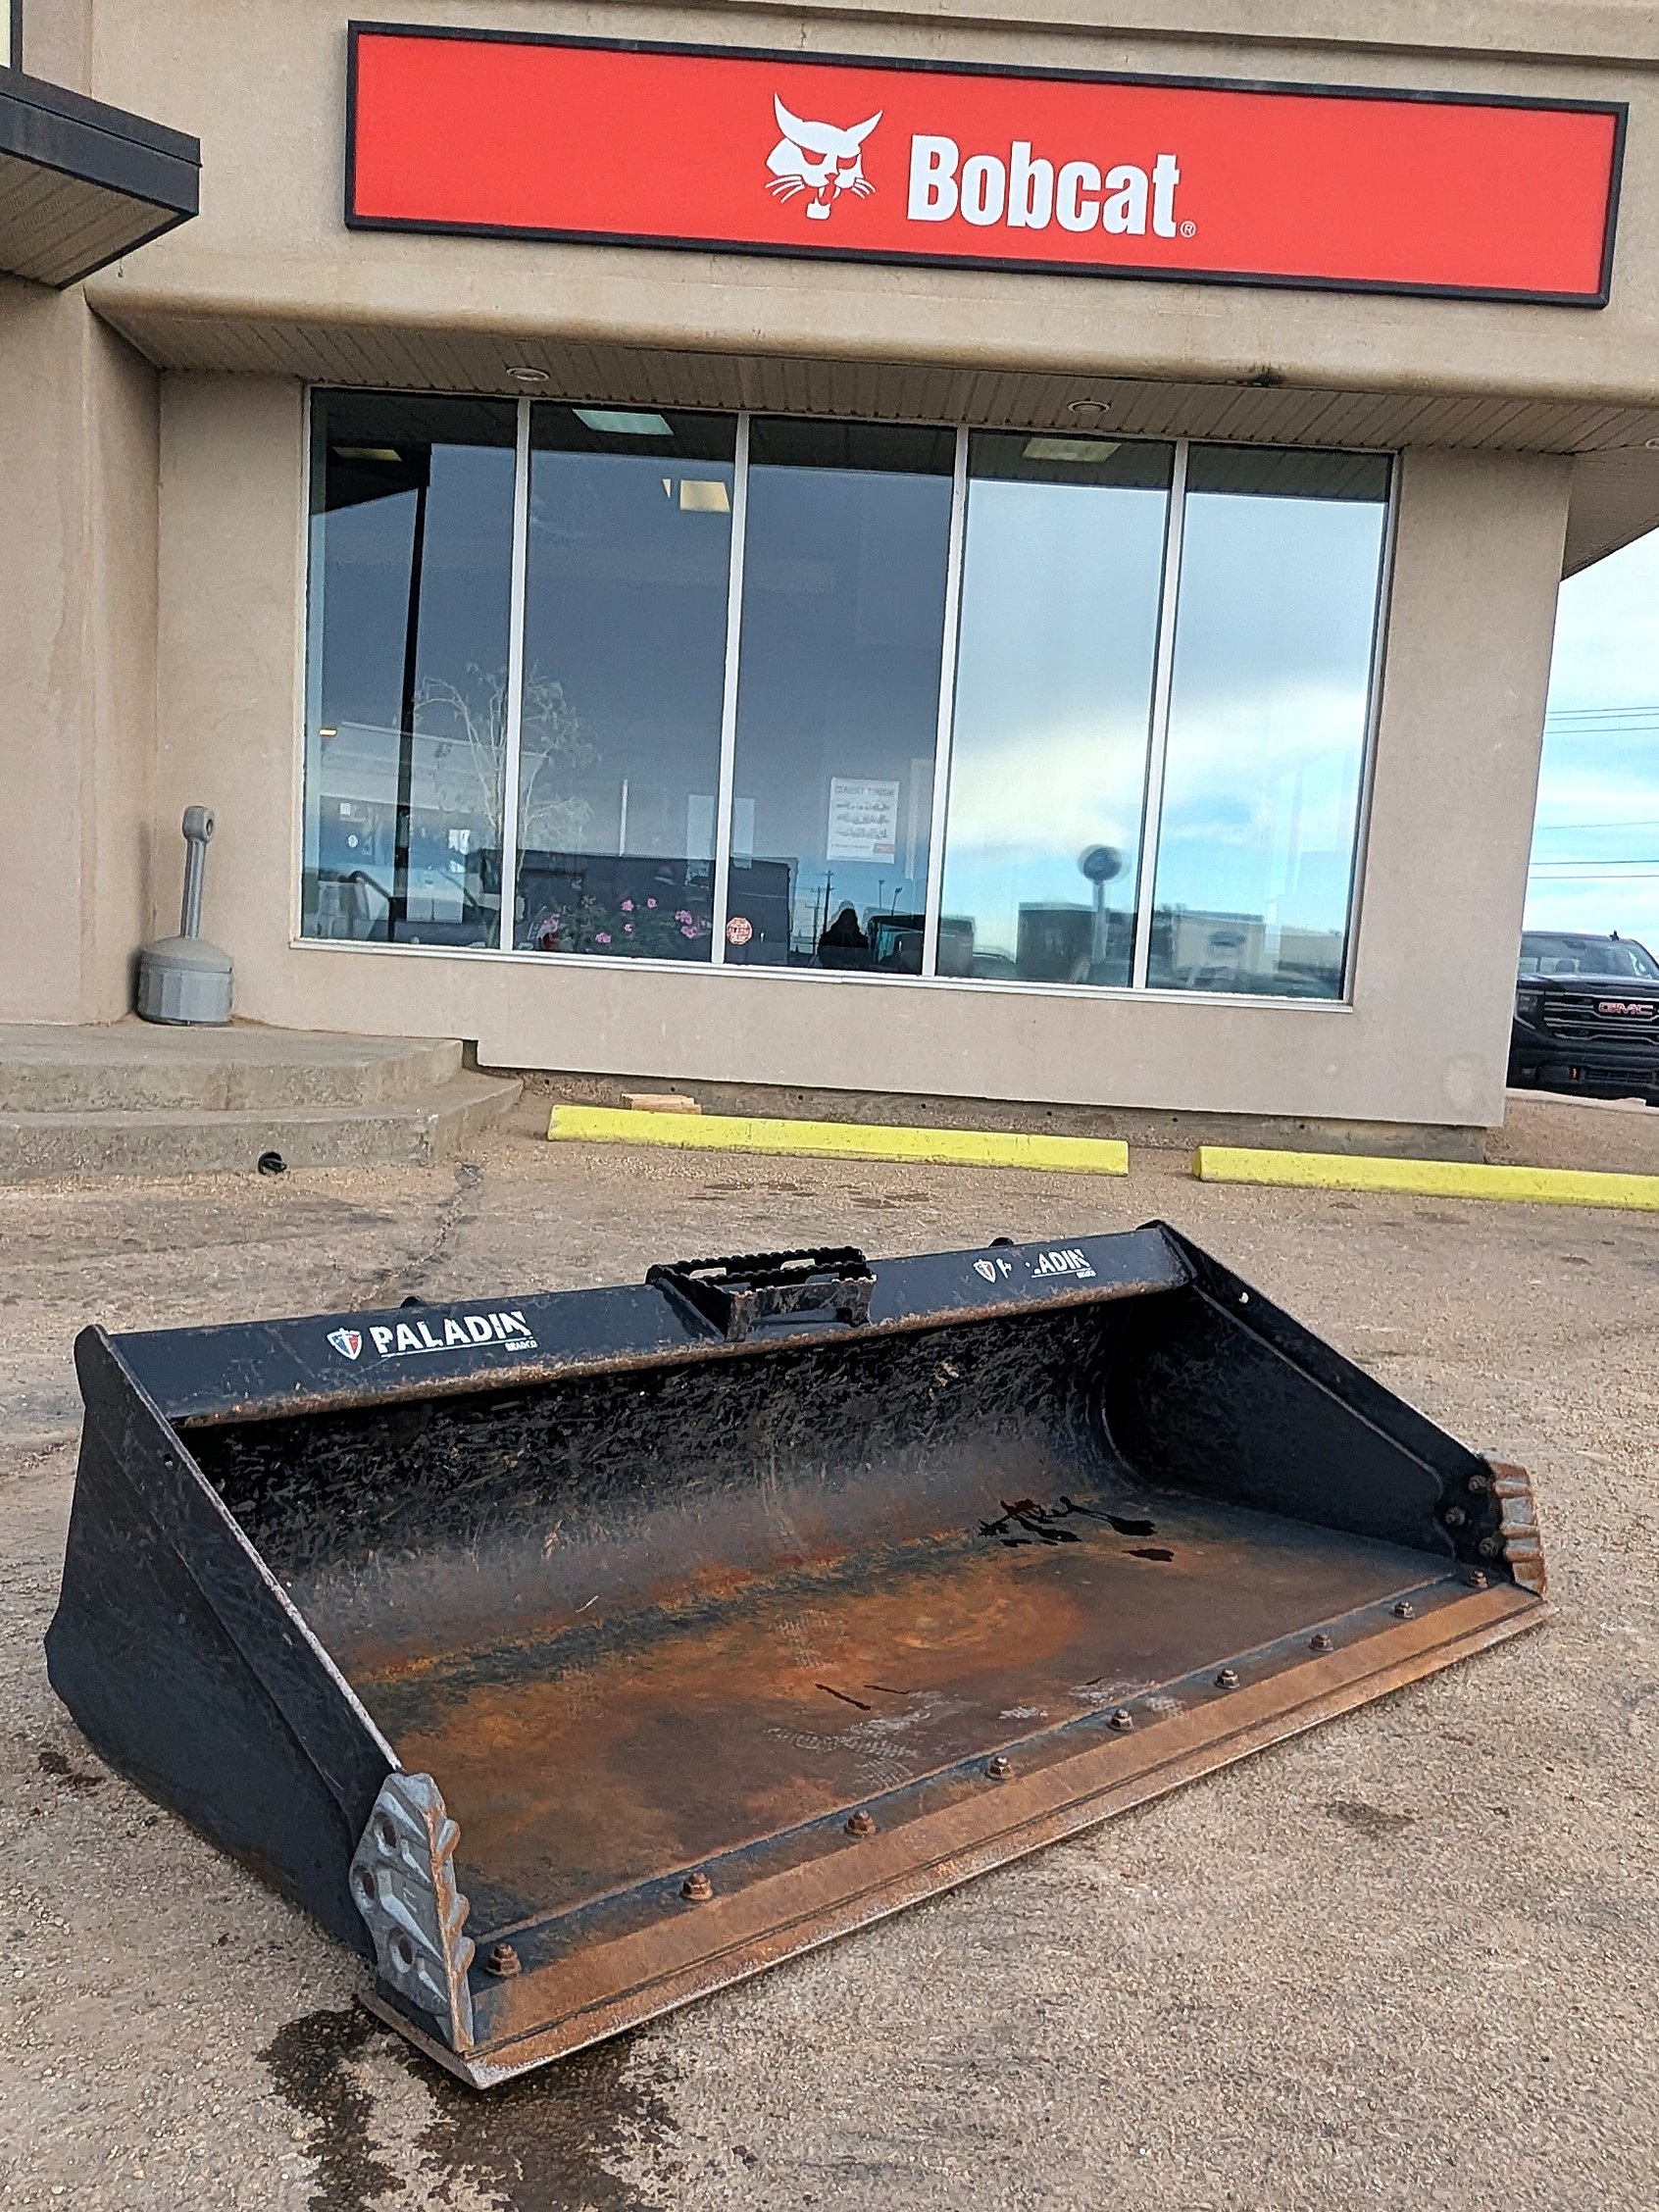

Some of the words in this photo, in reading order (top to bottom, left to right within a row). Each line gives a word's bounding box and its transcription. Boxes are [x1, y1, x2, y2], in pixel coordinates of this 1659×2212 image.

[907, 134, 1180, 238] Bobcat
[1597, 1001, 1654, 1016] GMC
[369, 1311, 531, 1354] PALADIN
